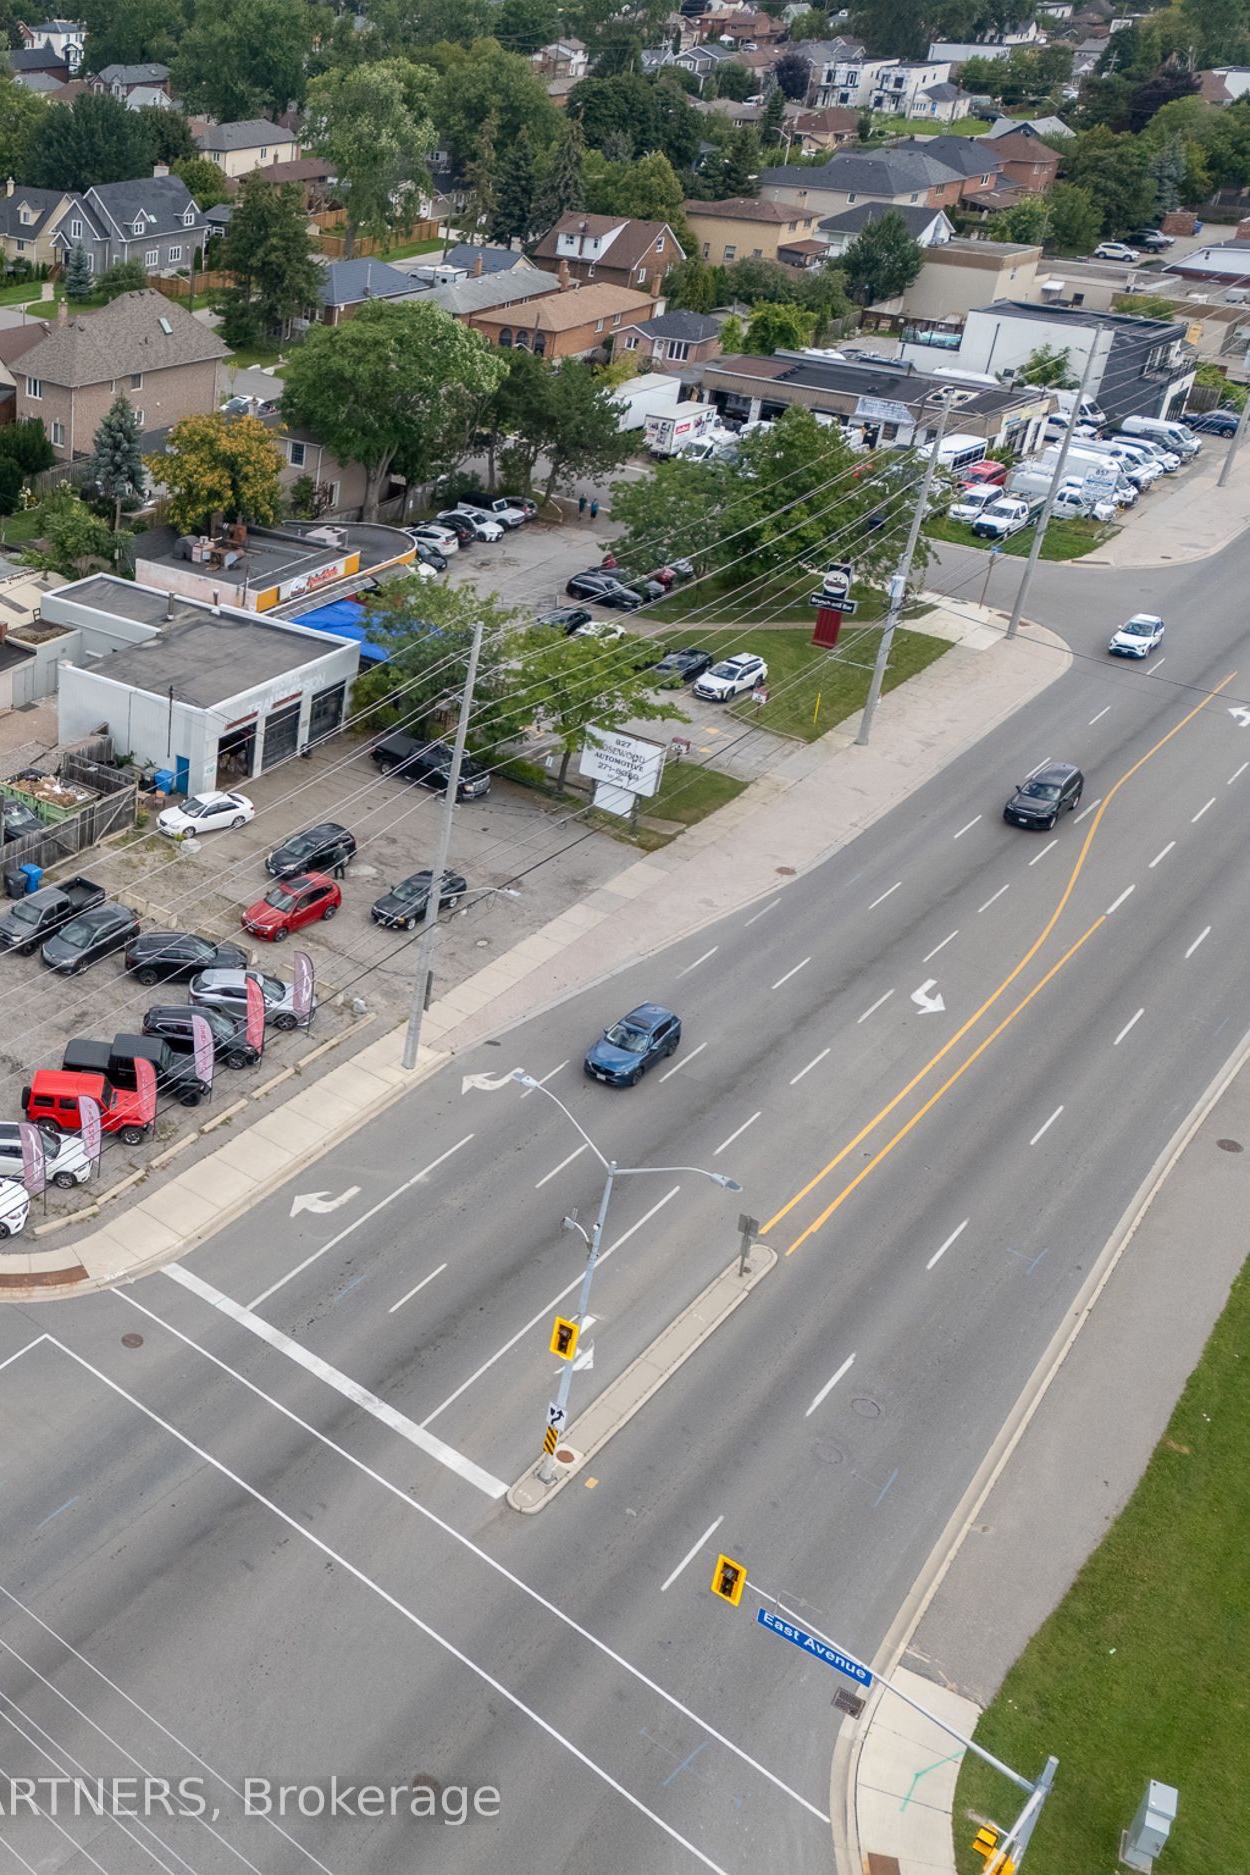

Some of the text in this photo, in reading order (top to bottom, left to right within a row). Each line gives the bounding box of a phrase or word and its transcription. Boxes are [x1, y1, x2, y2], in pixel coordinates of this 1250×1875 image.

[594, 751, 644, 772] AUTOMOTIVE
[600, 743, 646, 764] OSEWOOD
[763, 1612, 866, 1679] East Avenue
